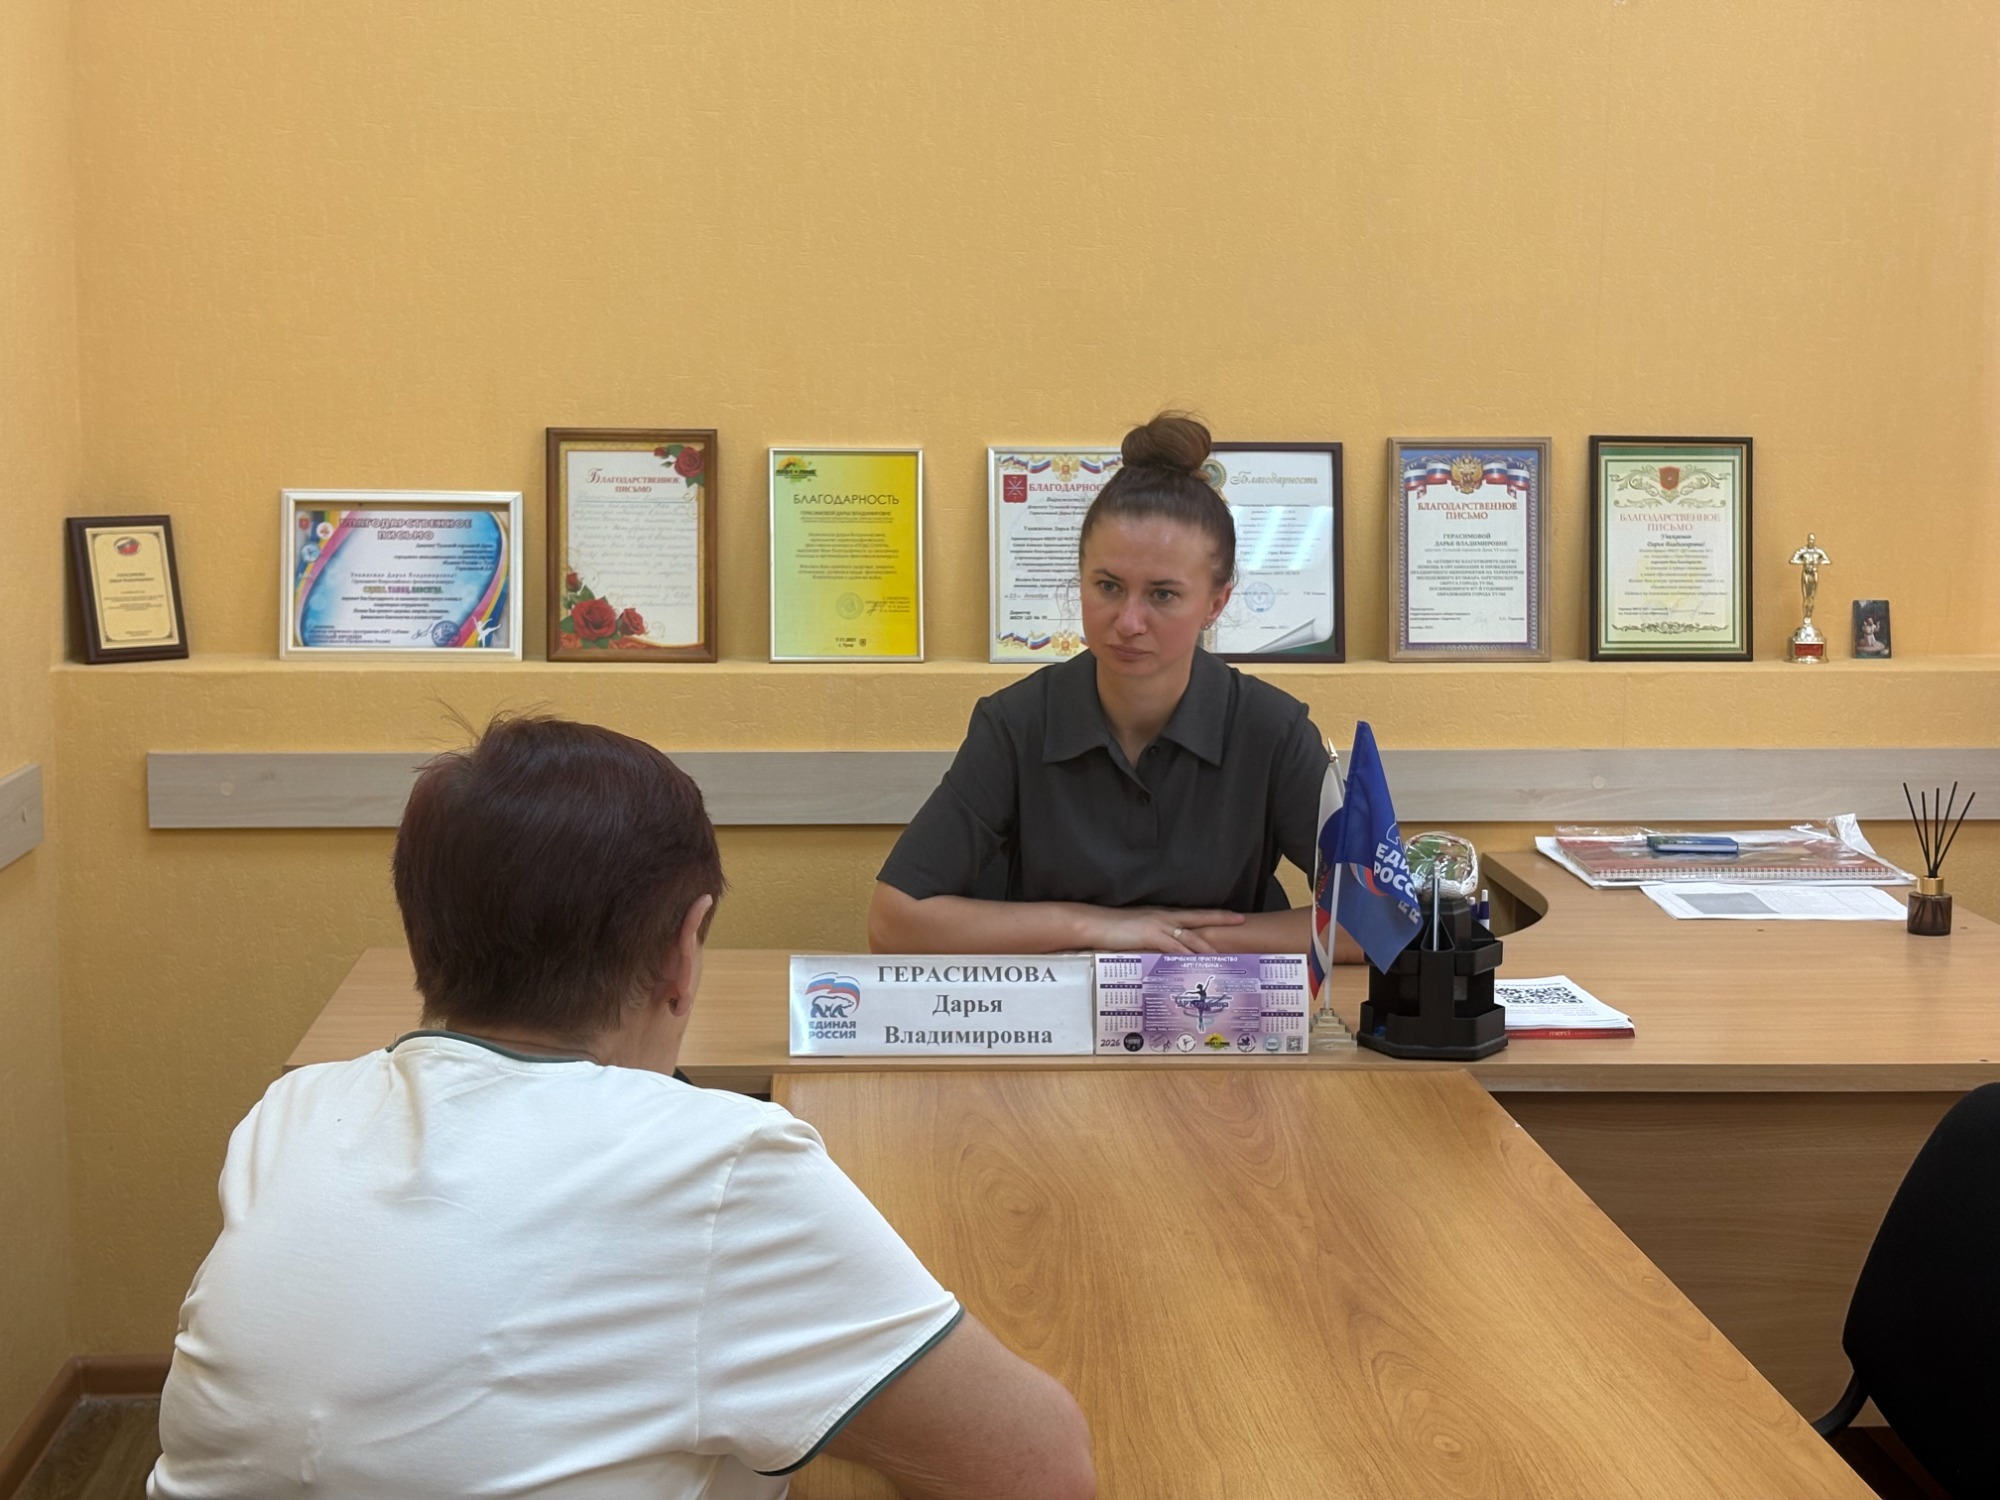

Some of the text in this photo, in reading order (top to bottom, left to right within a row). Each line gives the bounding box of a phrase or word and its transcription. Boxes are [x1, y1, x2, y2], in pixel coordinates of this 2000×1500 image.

[1229, 471, 1318, 488] Благодарность
[793, 494, 900, 505] БЛАГОДАРНОСТЬ
[1417, 502, 1517, 511] БЛАГОДАРСТВЕННОЕ
[1445, 511, 1488, 520] ПИСЬМО
[1619, 513, 1721, 522] БЛАГОДАРСТВЕННОЕ
[339, 518, 473, 529] БЛАГОДАРСТВЕННОЕ
[1647, 523, 1693, 531] ПИСЬМО
[377, 530, 434, 541] ПИСЬМО
[877, 965, 1058, 983] ГЕРАСИМОВА
[932, 994, 1003, 1017] Дарья
[809, 1020, 857, 1030] ЕДИНАЯ
[809, 1030, 857, 1039] РОССИЯ
[883, 1025, 1053, 1049] Владимировна
[1100, 1038, 1121, 1047] 2026
